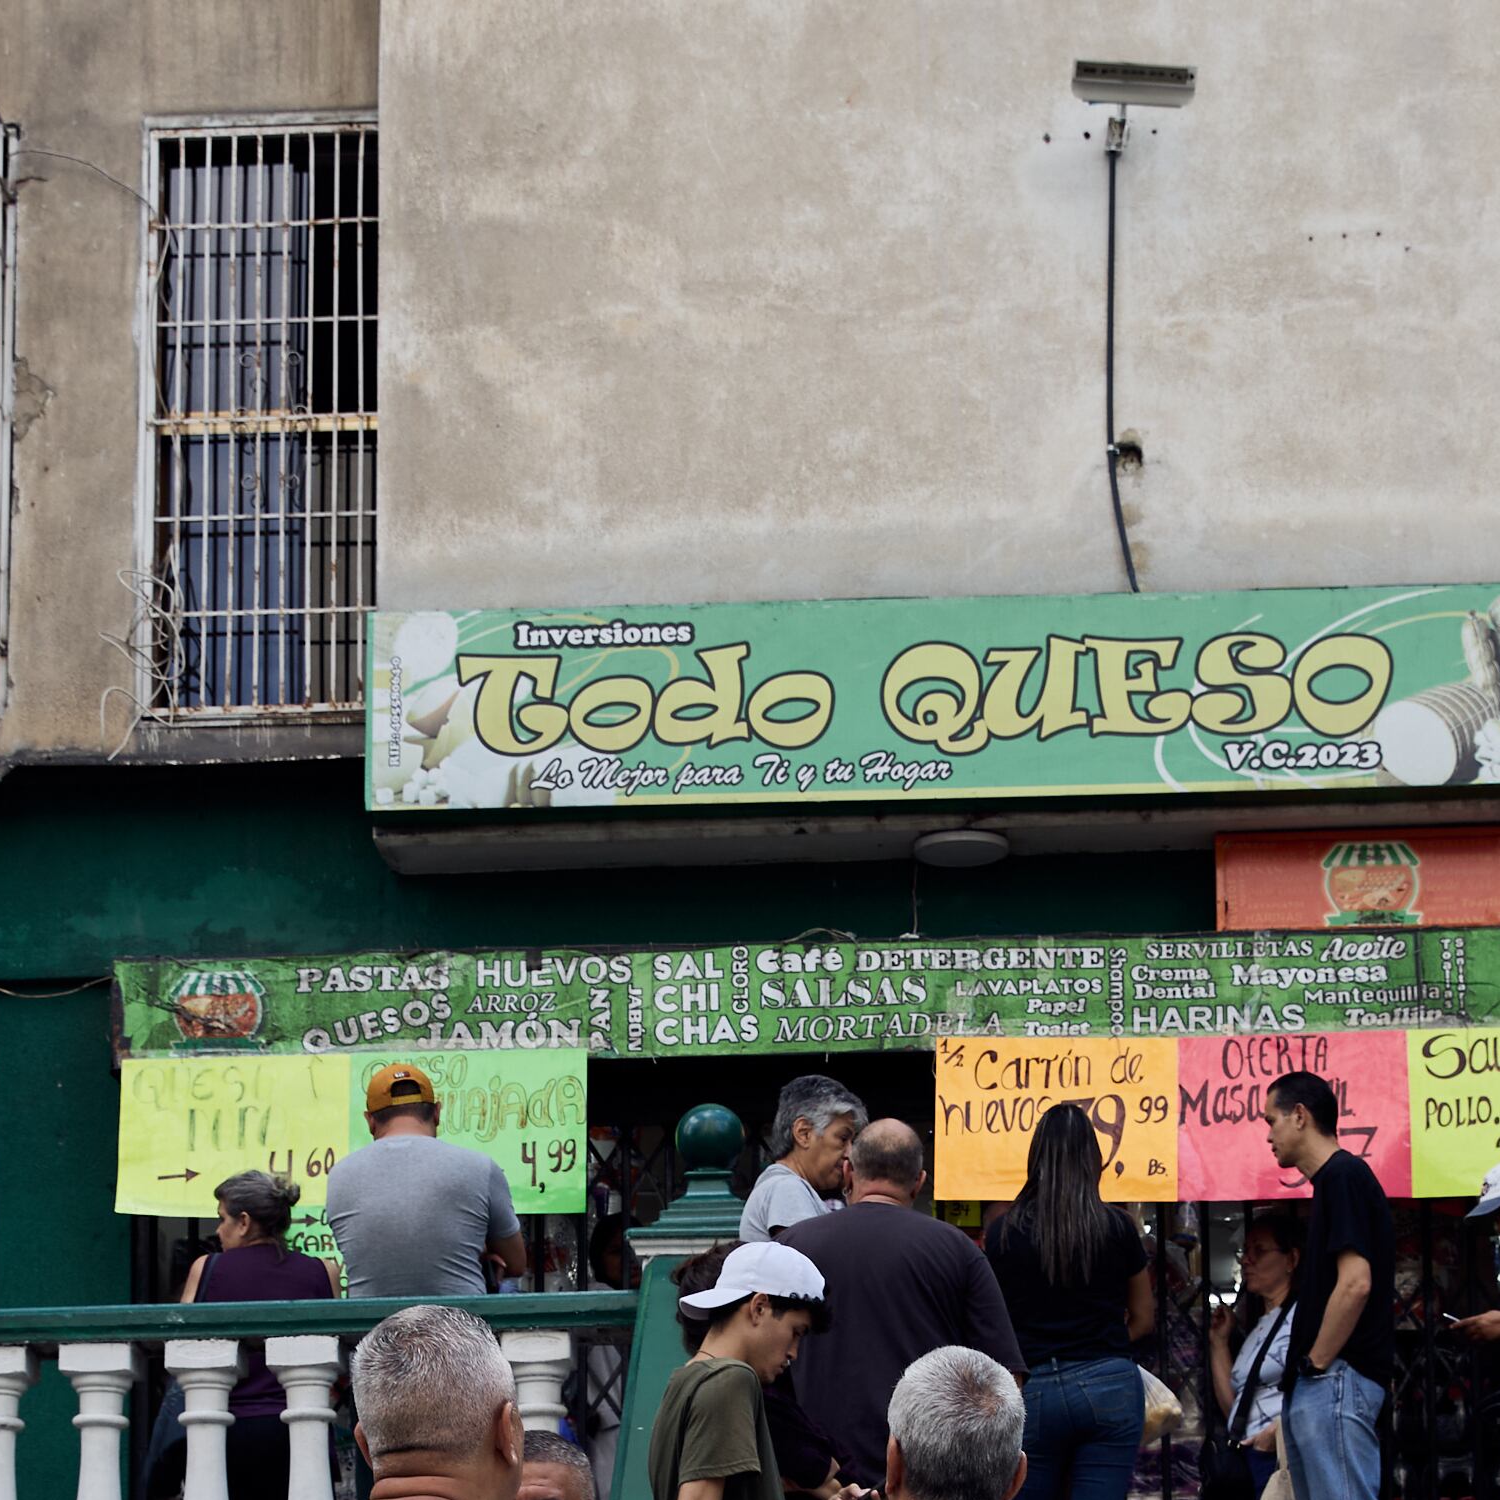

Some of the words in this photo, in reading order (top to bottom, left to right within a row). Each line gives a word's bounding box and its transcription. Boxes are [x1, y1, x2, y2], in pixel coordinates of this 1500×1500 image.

[514, 619, 694, 650] Inversiones
[456, 642, 835, 757] Todo
[881, 632, 1393, 755] QUESO
[1223, 739, 1383, 771] V.C.2023
[529, 757, 574, 791] Lo
[579, 756, 669, 794] Mejor
[673, 764, 742, 795] para
[752, 752, 787, 785] Ti
[795, 761, 816, 792] y
[824, 757, 853, 784] tu
[856, 750, 952, 791] Hogar
[755, 946, 845, 974] Café
[854, 945, 1106, 973] DETERGENTE
[1146, 939, 1314, 960] SERVILLETAS
[1319, 934, 1408, 962] Aceite
[296, 964, 450, 992] PASTAS
[476, 954, 633, 988] HUEVOS
[653, 951, 725, 981] SAL
[730, 944, 750, 1014] CLORO
[1130, 964, 1211, 982] Crema
[1231, 963, 1389, 990] Mayonesa
[654, 982, 720, 1014] CHI
[760, 975, 928, 1009] SALSAS
[954, 976, 1103, 997] LAVAPLATOS
[1107, 948, 1128, 1036] Shampoo
[1133, 982, 1218, 1001] Dental
[466, 992, 557, 1013] ARROZ
[1025, 997, 1087, 1016] Papel
[301, 992, 452, 1054] QUESOS
[416, 1012, 582, 1050] JAMÓN
[654, 1013, 760, 1046] CHAS
[1024, 1020, 1091, 1037] Toalet
[1132, 1004, 1307, 1034] HARINAS
